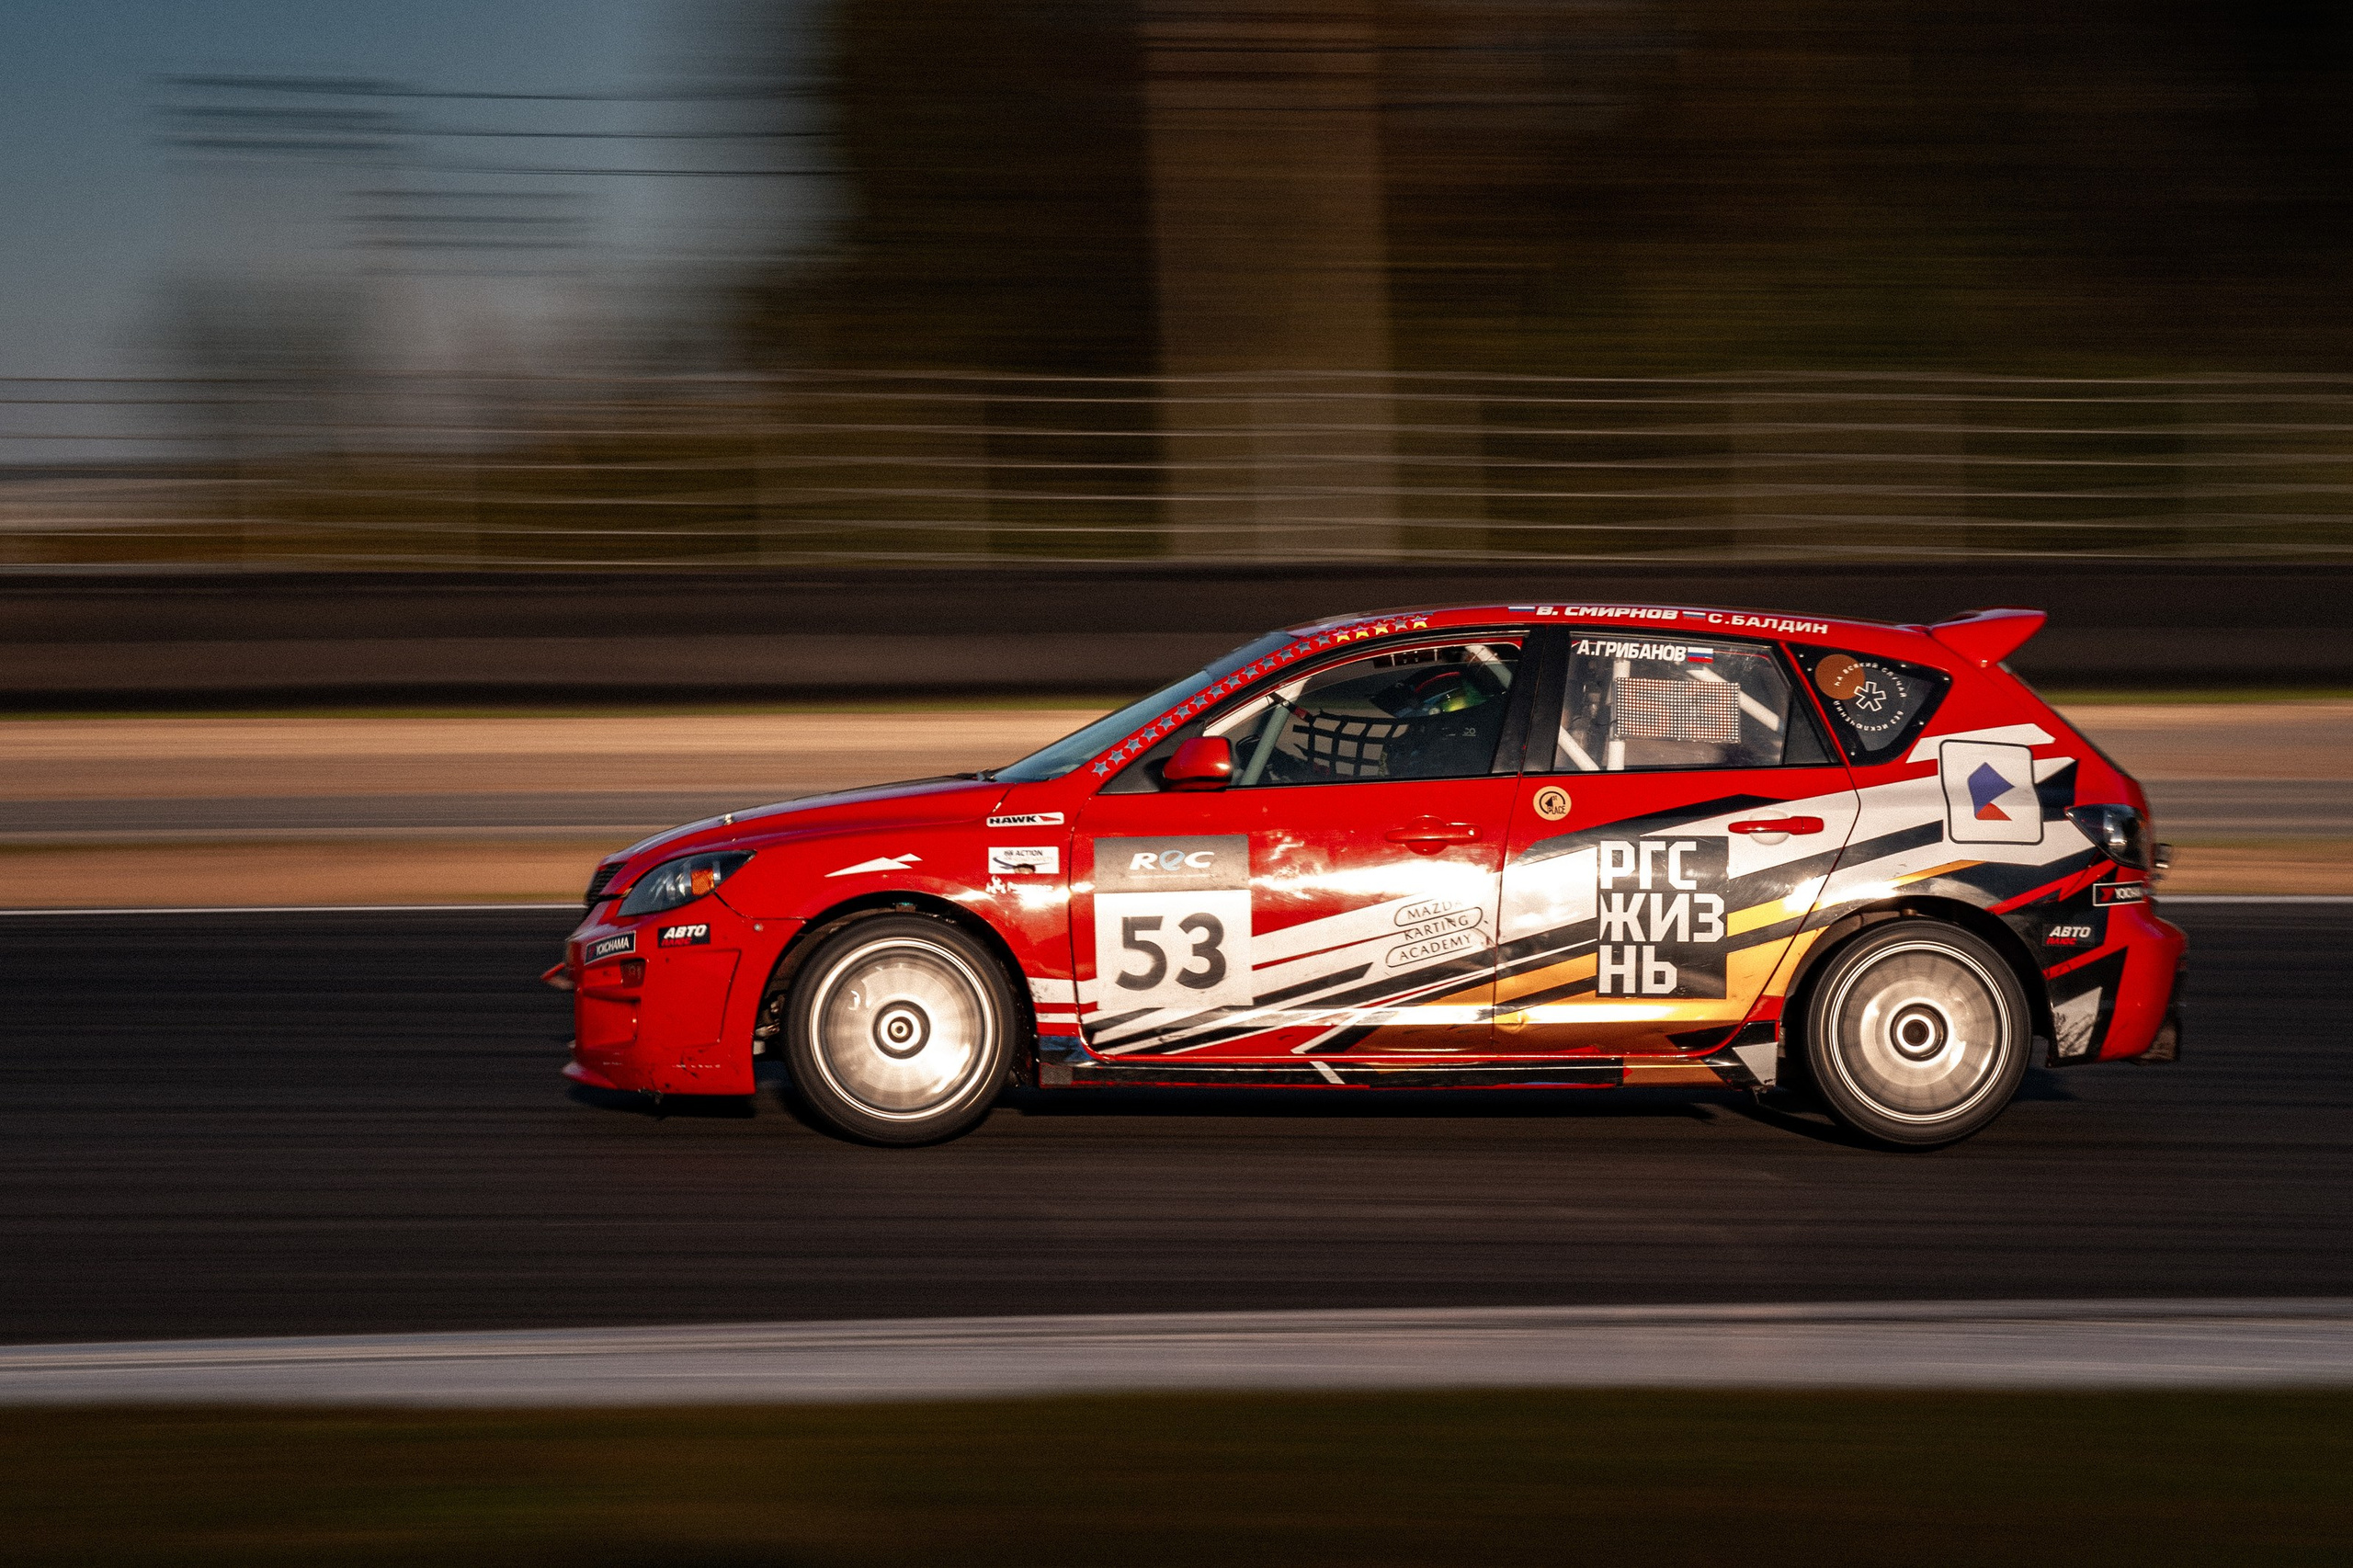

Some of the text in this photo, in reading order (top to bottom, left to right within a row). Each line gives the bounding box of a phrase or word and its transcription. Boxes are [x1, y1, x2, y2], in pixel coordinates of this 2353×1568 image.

[1536, 607, 1678, 619] В. СМИРНОВ
[1708, 613, 1828, 634] С.БАЛДИН
[1576, 640, 1686, 662] А.ГРИБАНОВ
[989, 815, 1037, 824] HAWK
[1600, 841, 1697, 890] РГС
[1404, 915, 1469, 941] KARTING
[1599, 893, 1724, 942] ЖИЗ
[664, 924, 707, 938] АВТО
[2050, 926, 2091, 937] АВТО
[596, 937, 630, 956] YOKOHAMA
[1115, 913, 1226, 991] 53
[1400, 934, 1471, 960] ACADEMY
[1598, 945, 1677, 994] НЬ
